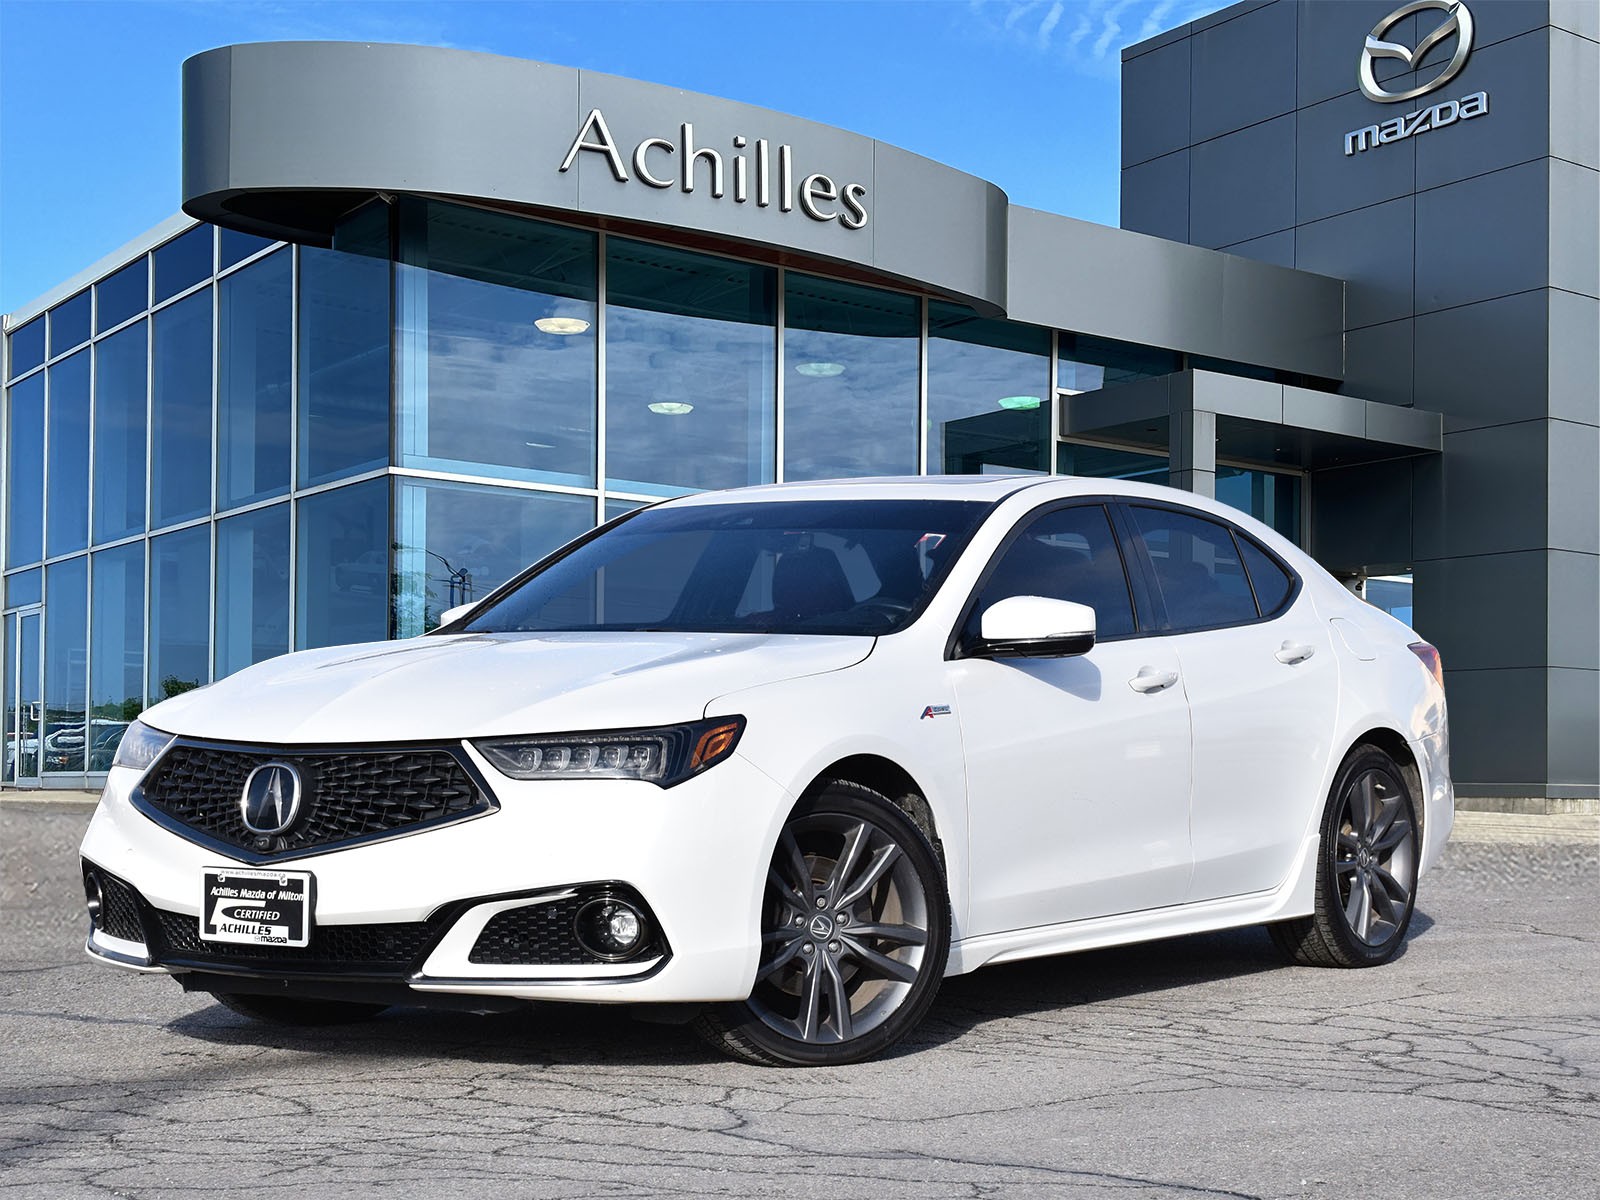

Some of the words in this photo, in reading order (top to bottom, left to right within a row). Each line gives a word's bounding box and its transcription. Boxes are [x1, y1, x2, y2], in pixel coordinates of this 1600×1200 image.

[558, 108, 868, 229] Achilles
[210, 886, 238, 897] Achilles
[240, 889, 265, 899] Mazda
[267, 891, 276, 900] of
[278, 891, 304, 901] Milton
[234, 909, 280, 920] CERTIFIED
[219, 923, 272, 935] ACHILLES
